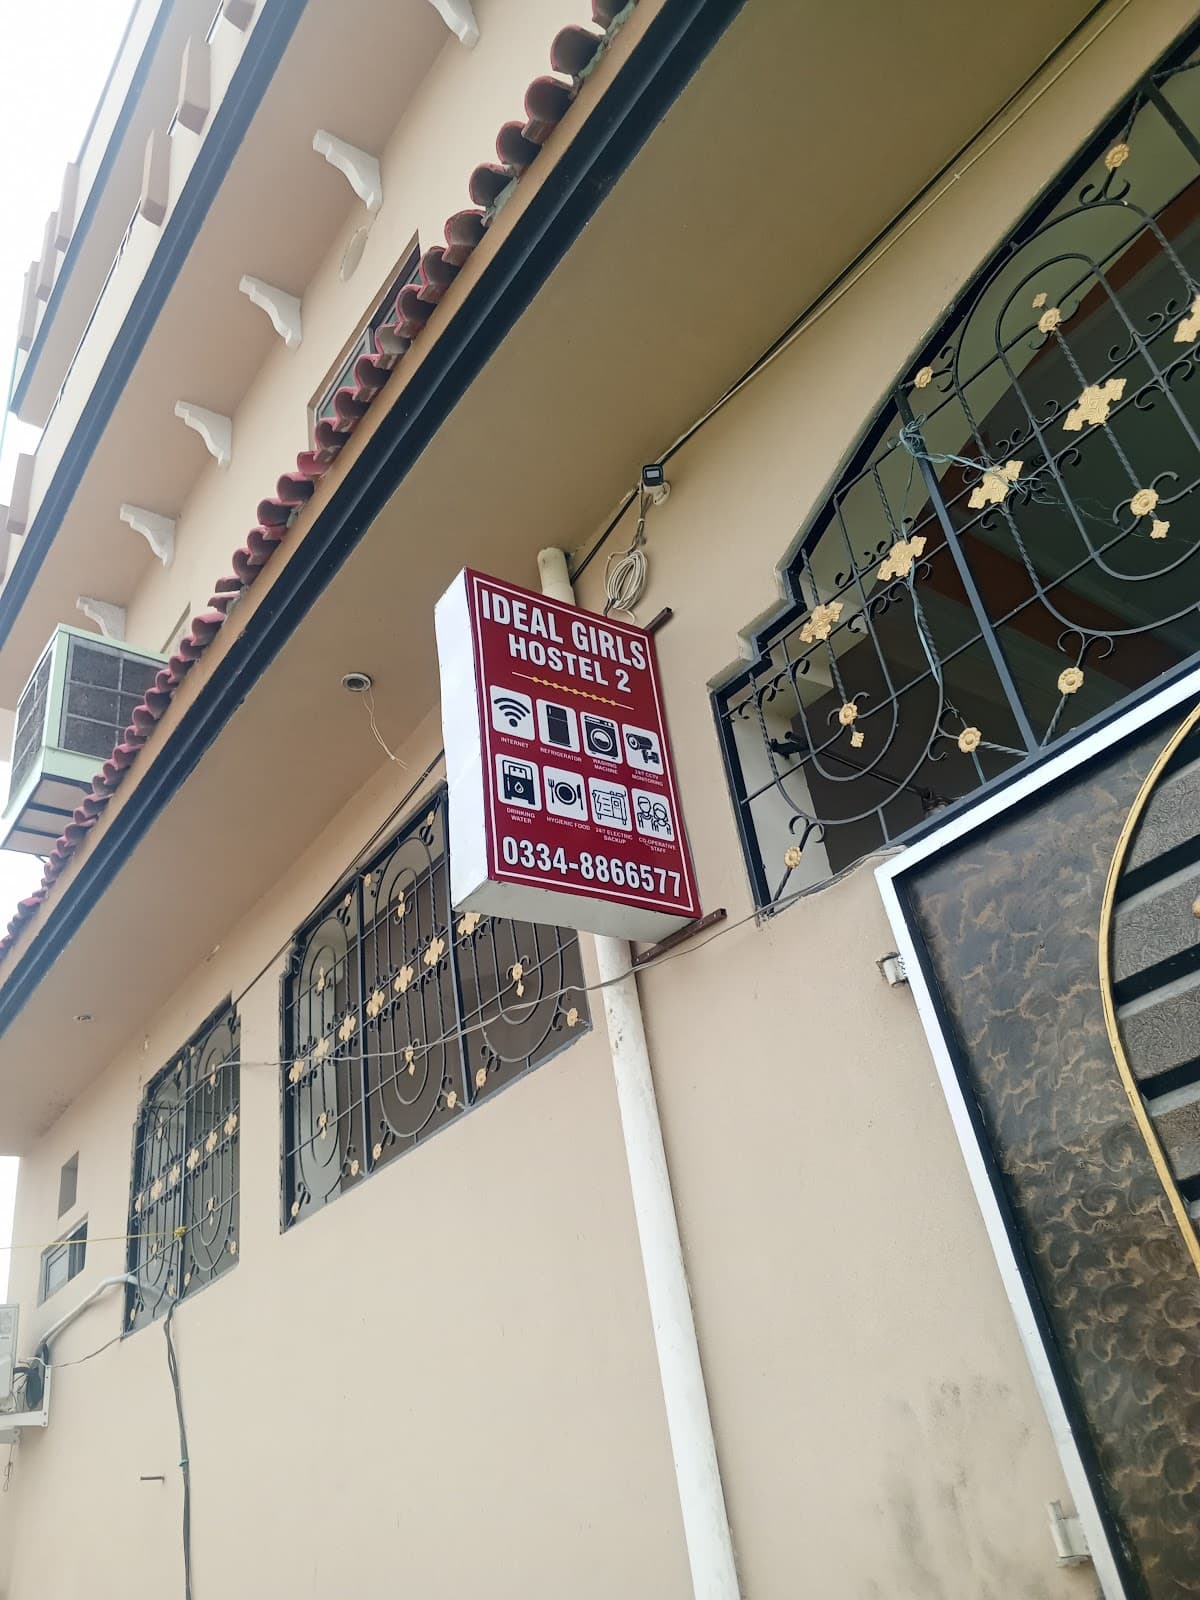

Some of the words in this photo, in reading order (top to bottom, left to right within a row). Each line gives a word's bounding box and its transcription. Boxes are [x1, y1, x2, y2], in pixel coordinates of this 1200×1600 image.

[481, 589, 564, 645] IDEAL
[571, 621, 647, 670] GIRLS
[508, 633, 609, 686] HOSTEL
[615, 669, 632, 693] 2
[500, 736, 529, 749] INTERNET
[540, 747, 582, 762] REFRIGERATOR
[592, 759, 617, 769] WASHING
[594, 764, 618, 775] MACHINE
[631, 774, 664, 787] MONITORING
[645, 771, 659, 780] CCTV
[506, 807, 536, 818] DRINKING
[511, 814, 532, 824] WATER
[546, 815, 574, 827] HYGIENIC
[574, 822, 591, 831] FOOD
[603, 835, 627, 845] BACKUP
[606, 830, 633, 841] ELECTRIC
[650, 845, 666, 854] STAFF
[502, 836, 681, 897] 0334-8866577
